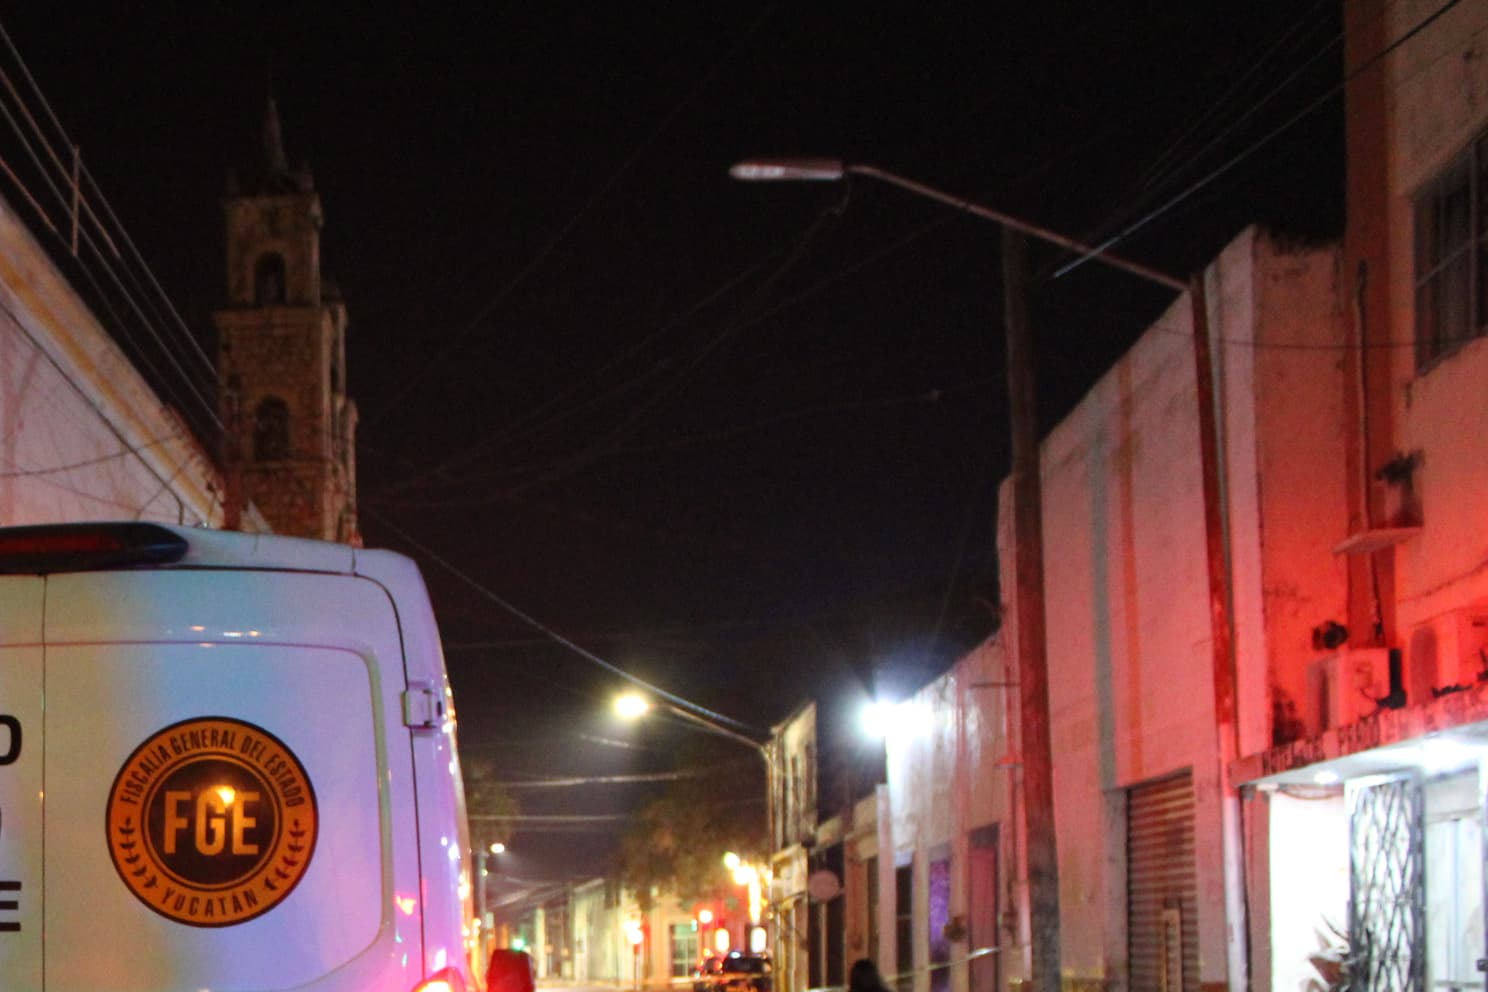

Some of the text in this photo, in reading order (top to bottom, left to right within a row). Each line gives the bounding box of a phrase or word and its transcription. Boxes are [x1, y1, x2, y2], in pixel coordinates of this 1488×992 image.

[170, 729, 236, 755] GENERAL
[240, 735, 268, 762] DEL
[264, 754, 305, 807] ESTADO
[164, 788, 260, 856] FGE
